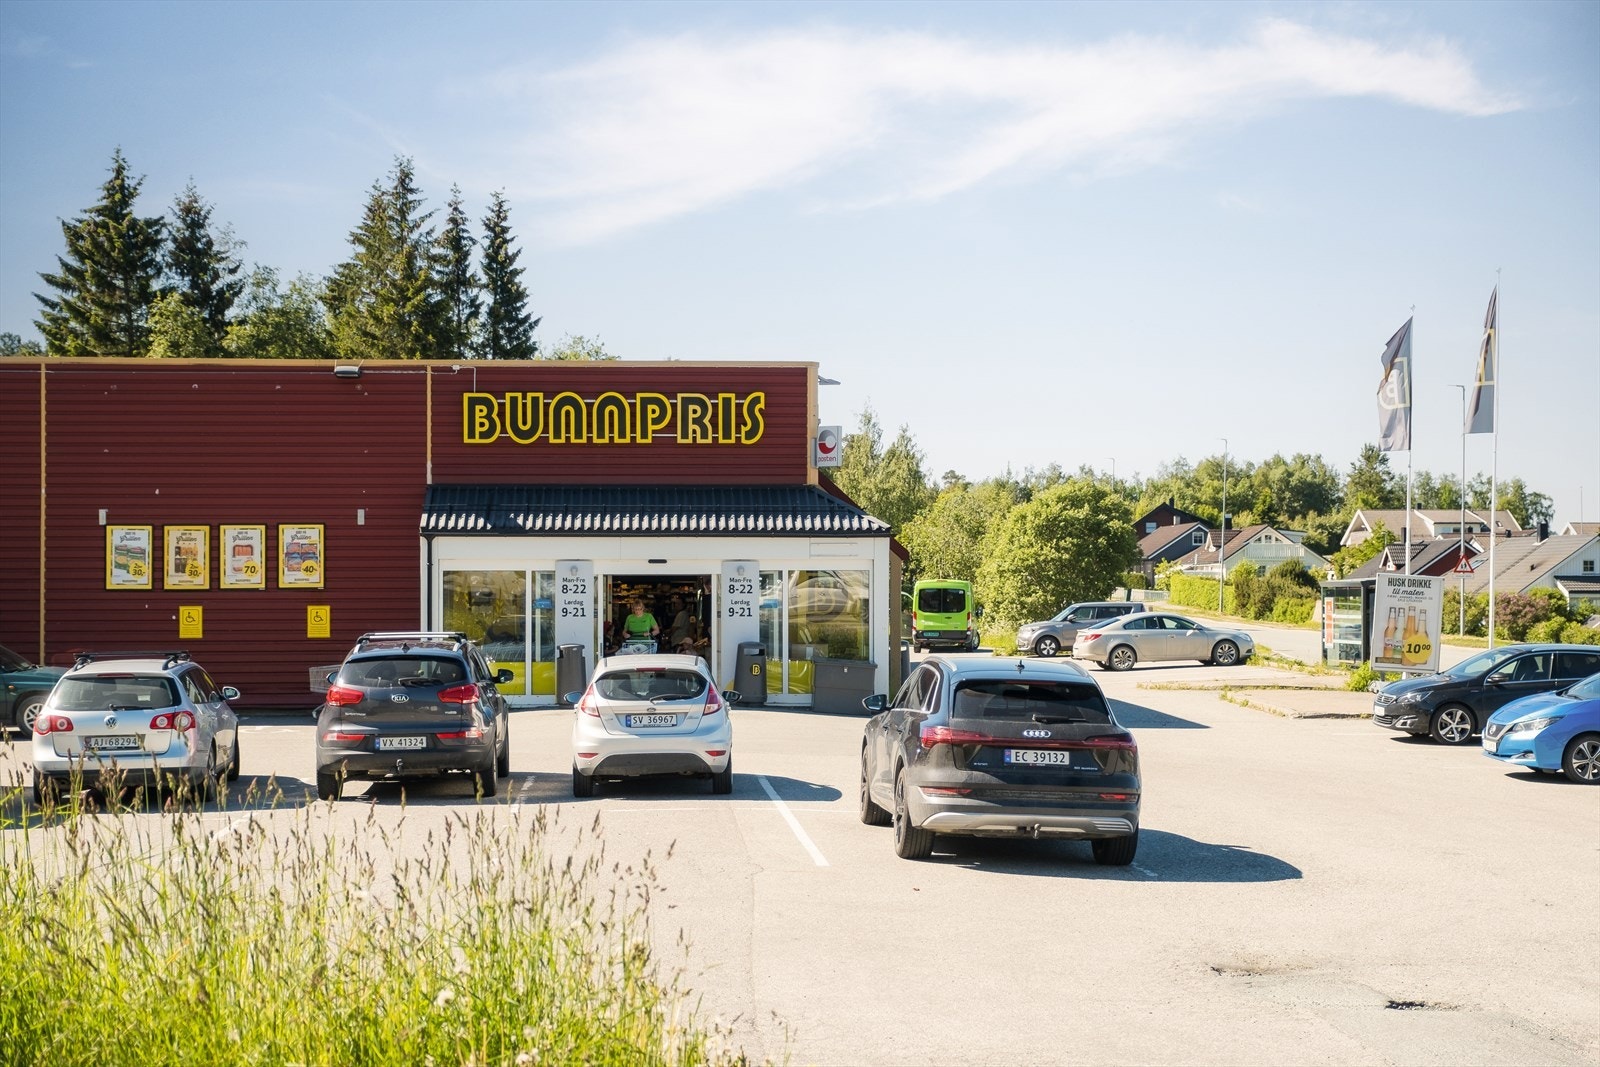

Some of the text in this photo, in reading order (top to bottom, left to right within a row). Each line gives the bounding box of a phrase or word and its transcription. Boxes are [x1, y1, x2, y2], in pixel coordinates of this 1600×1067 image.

[463, 391, 765, 445] BUNNPRIS
[1387, 577, 1432, 589] HUSK DRIKKE
[561, 584, 587, 594] 8-22
[728, 584, 753, 594] 8-22
[561, 607, 586, 617] 9-21
[728, 607, 752, 617] 9-21
[632, 715, 674, 724] SV 36967
[93, 737, 137, 747] AJ 68294
[382, 737, 424, 747] VX 41324
[1015, 752, 1066, 763] EC 39132
